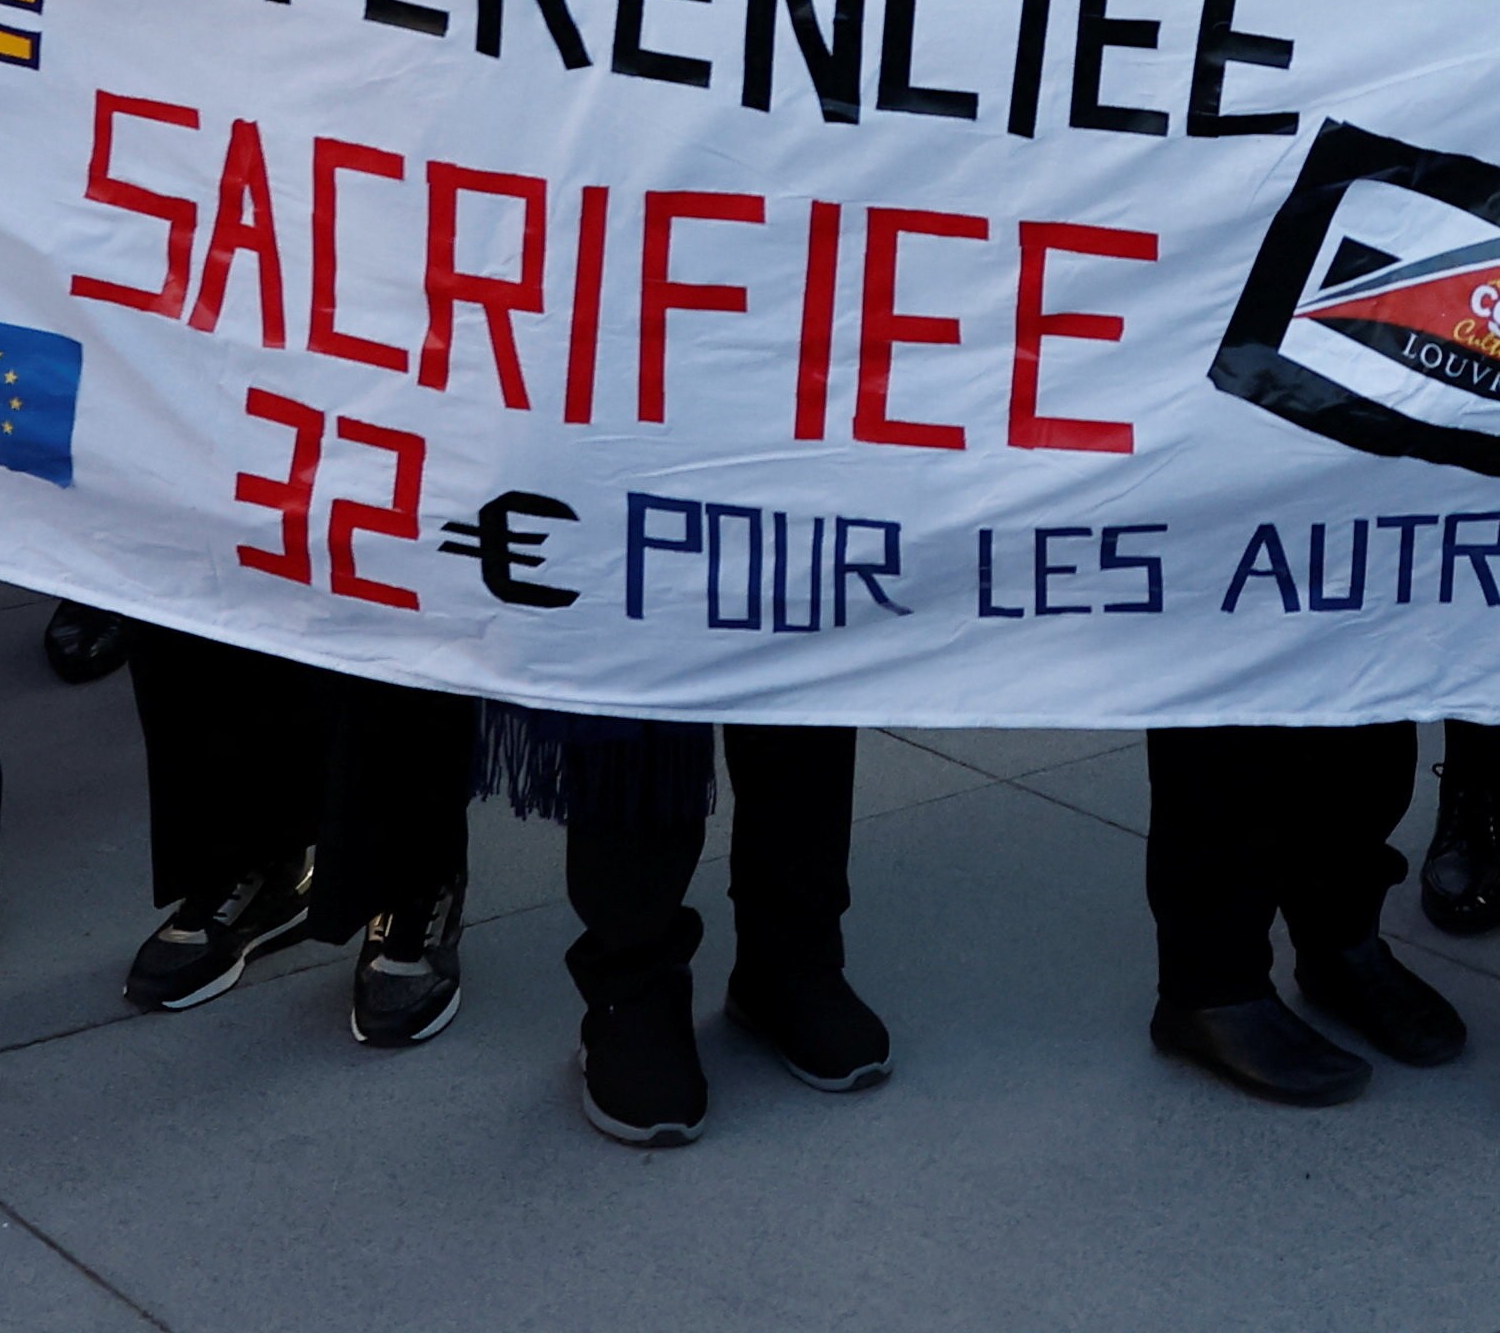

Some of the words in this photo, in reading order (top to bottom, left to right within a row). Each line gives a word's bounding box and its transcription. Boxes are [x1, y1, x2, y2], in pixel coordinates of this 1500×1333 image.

[70, 89, 1159, 454] SACRIFIEE
[627, 492, 911, 633] POUR
[979, 524, 1167, 619] LES
